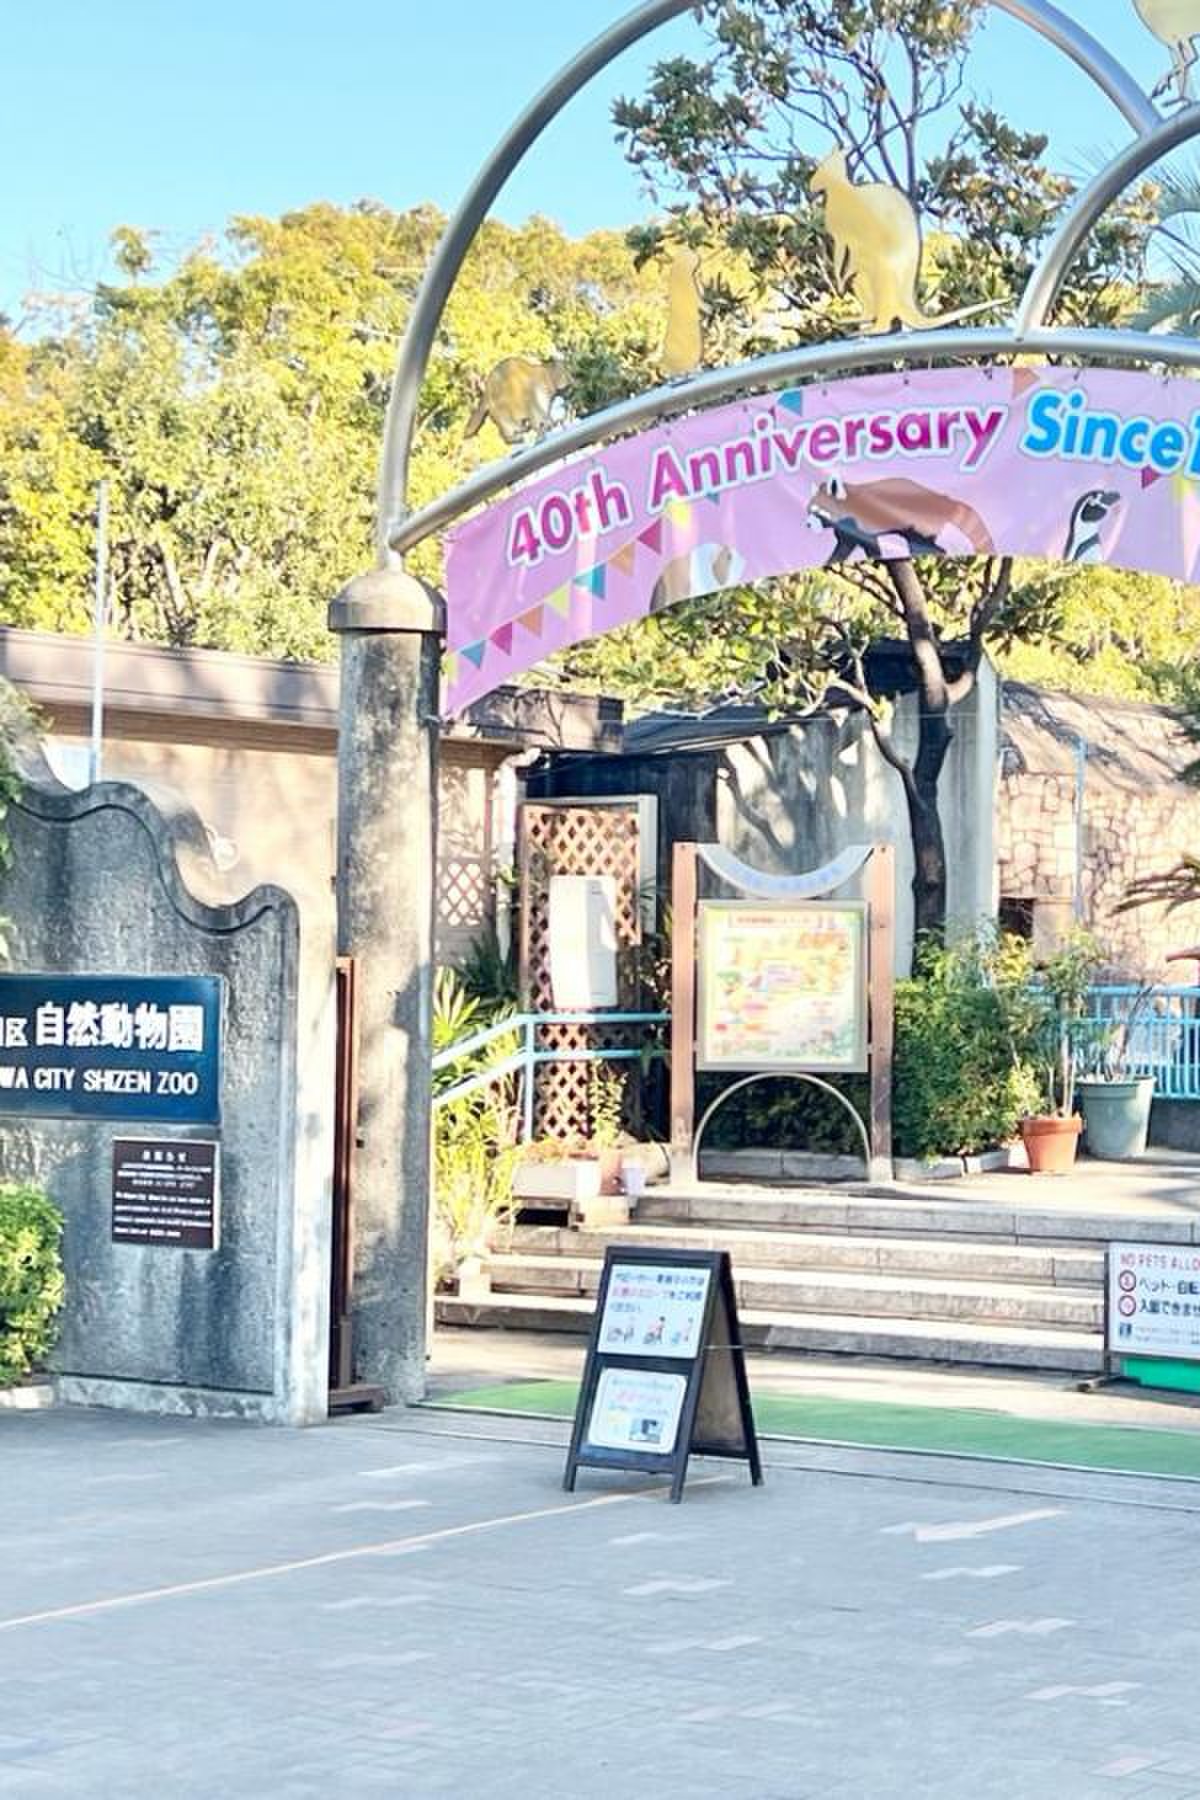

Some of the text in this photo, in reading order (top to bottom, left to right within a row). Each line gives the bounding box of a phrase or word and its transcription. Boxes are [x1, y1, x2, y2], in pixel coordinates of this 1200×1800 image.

[507, 471, 631, 565] 40th
[647, 406, 1006, 508] Anniversary
[36, 1001, 204, 1051] 自然動物園
[33, 1067, 76, 1091] CITY
[83, 1068, 151, 1094] SHIZEN
[157, 1070, 199, 1095] ZOO
[1139, 1253, 1167, 1269] PETS
